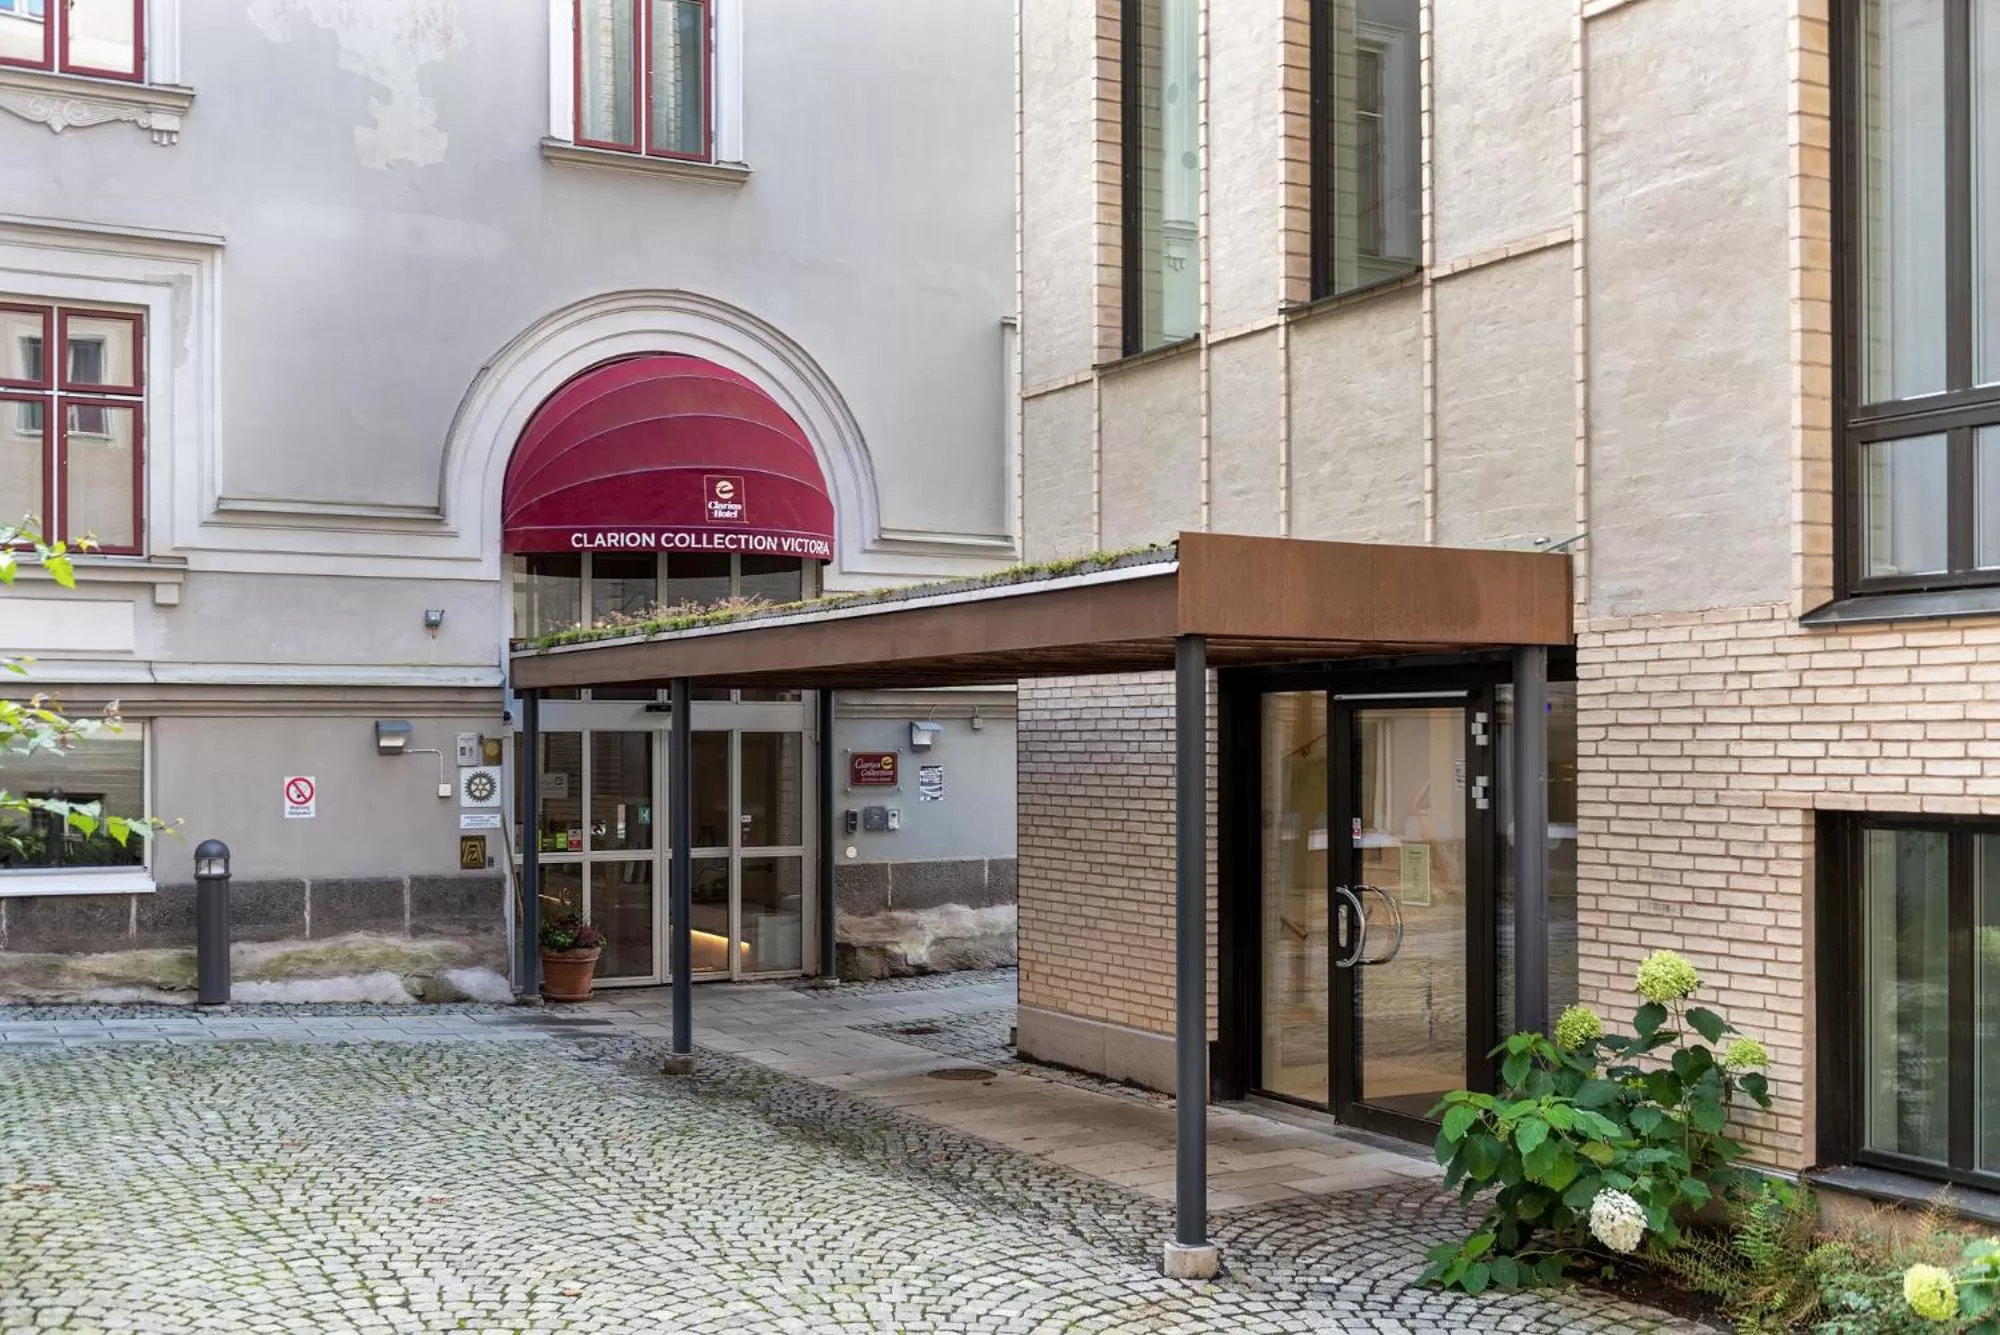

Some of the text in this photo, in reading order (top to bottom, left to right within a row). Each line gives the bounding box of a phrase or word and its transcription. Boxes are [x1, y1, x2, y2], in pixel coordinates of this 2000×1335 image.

[571, 532, 830, 555] CLARION COLLECTION VICTORIA
